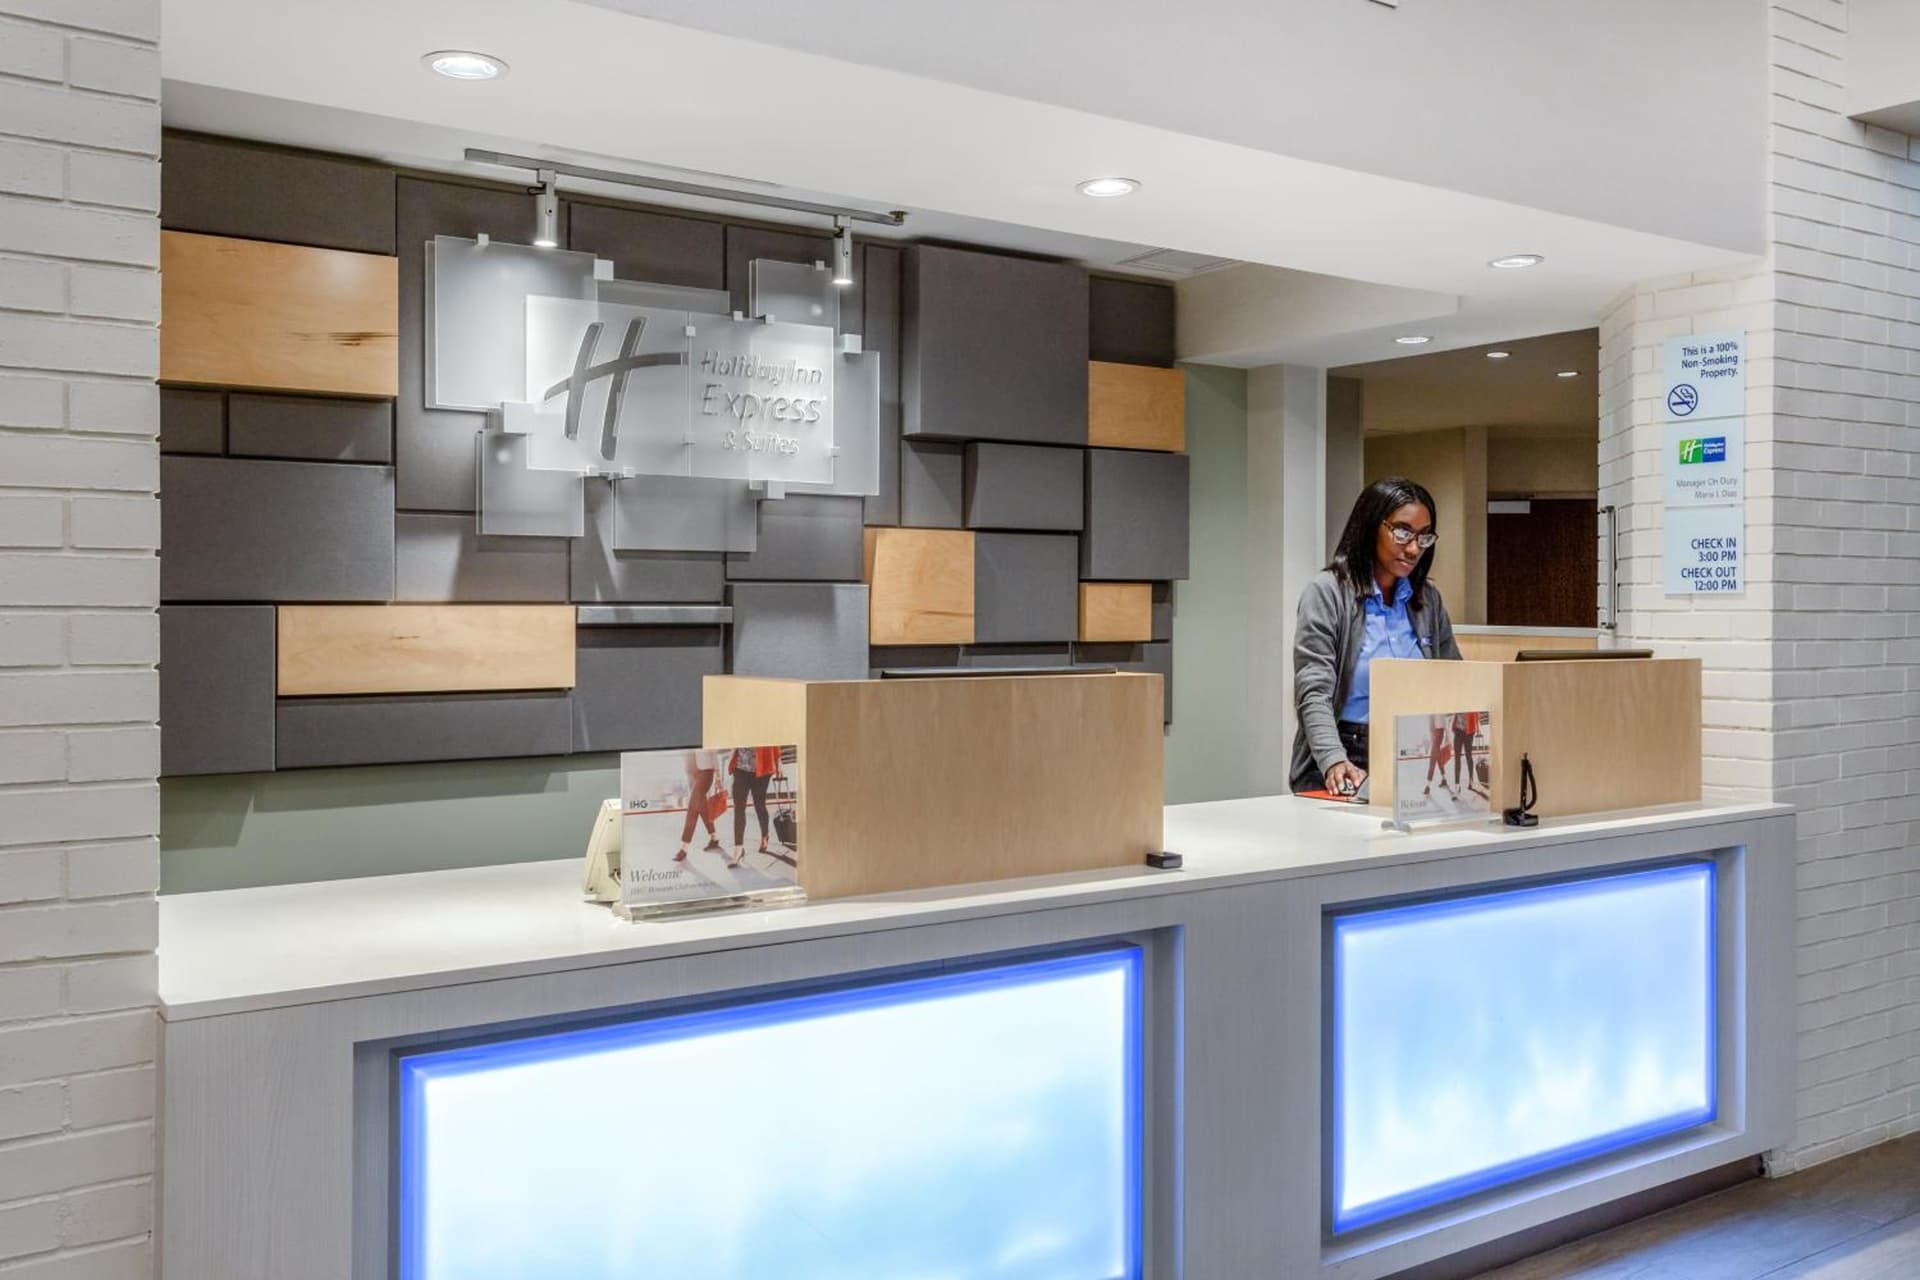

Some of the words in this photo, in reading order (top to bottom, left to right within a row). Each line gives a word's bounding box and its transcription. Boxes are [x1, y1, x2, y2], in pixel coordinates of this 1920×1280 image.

[1682, 347, 1698, 356] This
[1701, 345, 1707, 354] is
[1717, 341, 1738, 352] 100%
[1681, 355, 1738, 368] Non-Smoking
[700, 351, 785, 385] Holiday
[789, 358, 824, 384] Inn
[1700, 367, 1738, 378] Property.
[702, 383, 826, 427] Express
[722, 430, 736, 450] &
[742, 431, 800, 455] Suites
[1691, 537, 1724, 549] CHECK
[1726, 537, 1737, 548] IN
[1698, 551, 1719, 562] 3:00
[1721, 550, 1737, 561] PM
[1681, 567, 1713, 578] CHECK
[1715, 566, 1737, 578] OUT
[1694, 580, 1719, 591] 12:00
[1721, 579, 1737, 590] PM
[629, 799, 649, 809] IHG
[630, 868, 683, 882] Welcome
